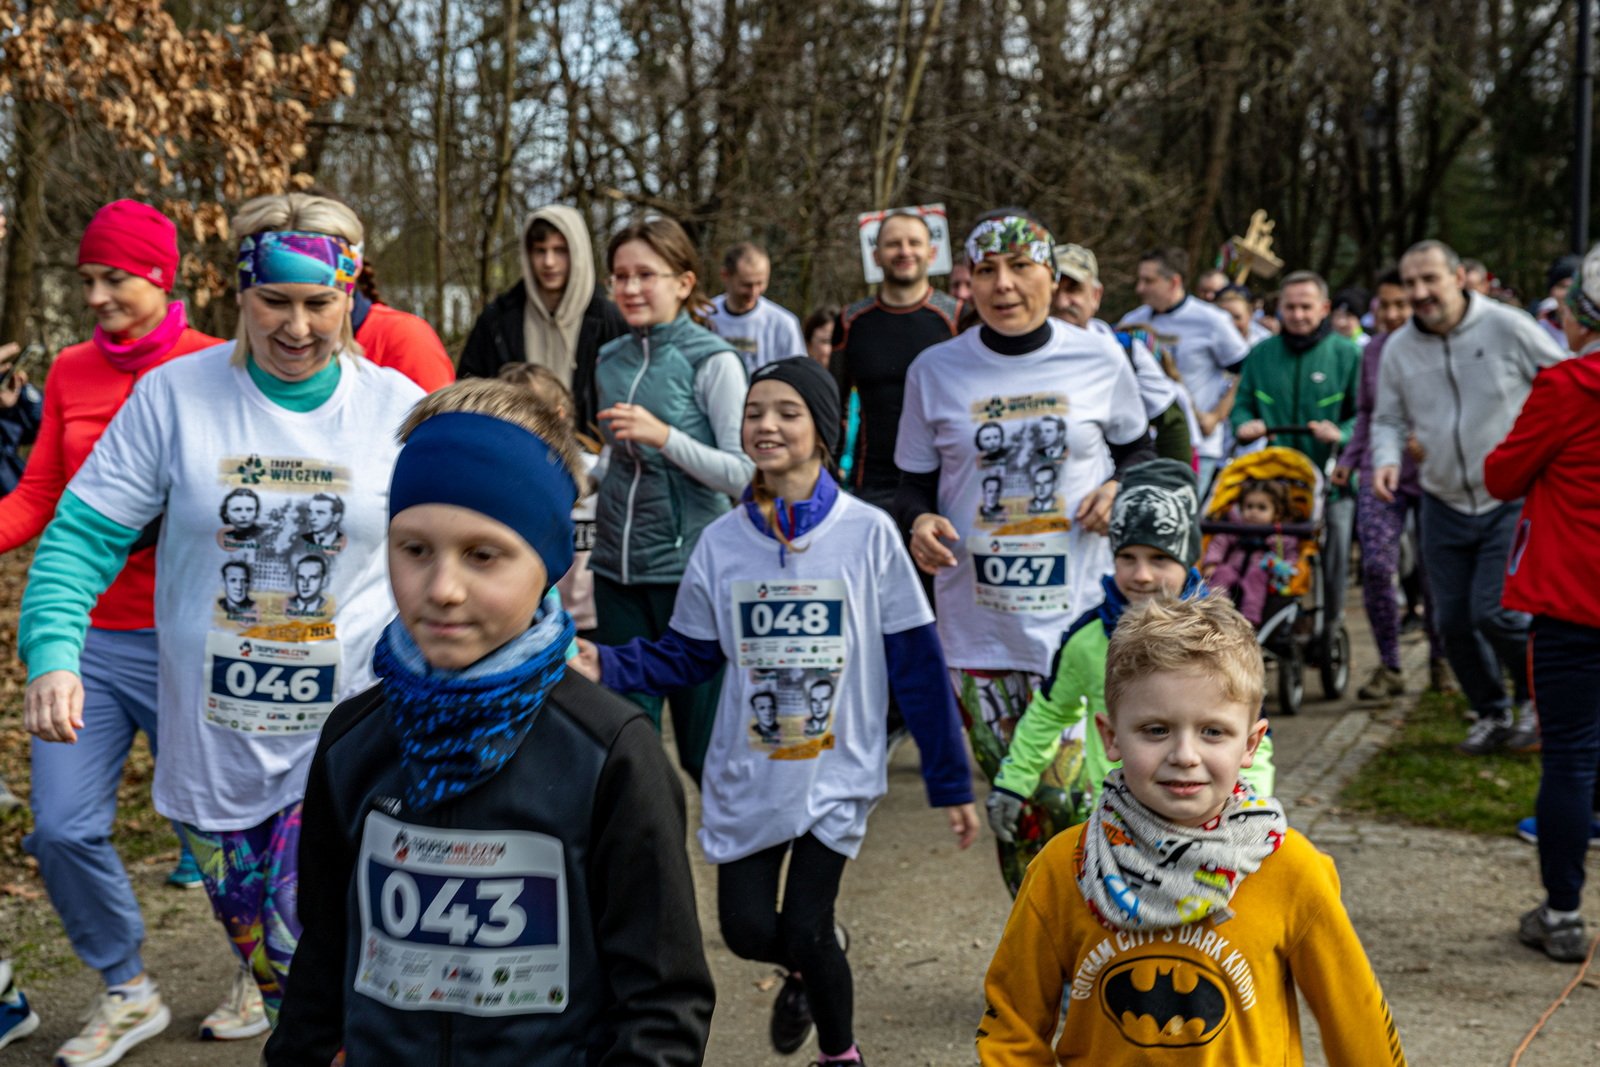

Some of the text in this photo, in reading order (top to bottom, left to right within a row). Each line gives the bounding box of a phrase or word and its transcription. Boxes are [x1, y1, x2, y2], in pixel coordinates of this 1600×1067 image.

[270, 459, 303, 468] TROPEM
[270, 468, 333, 482] WILCZYM
[983, 556, 1056, 585] 047
[750, 602, 830, 636] 048
[225, 661, 321, 702] 046
[380, 869, 528, 947] 043
[1071, 938, 1118, 1000] GOTHAM
[1178, 924, 1230, 961] DARK
